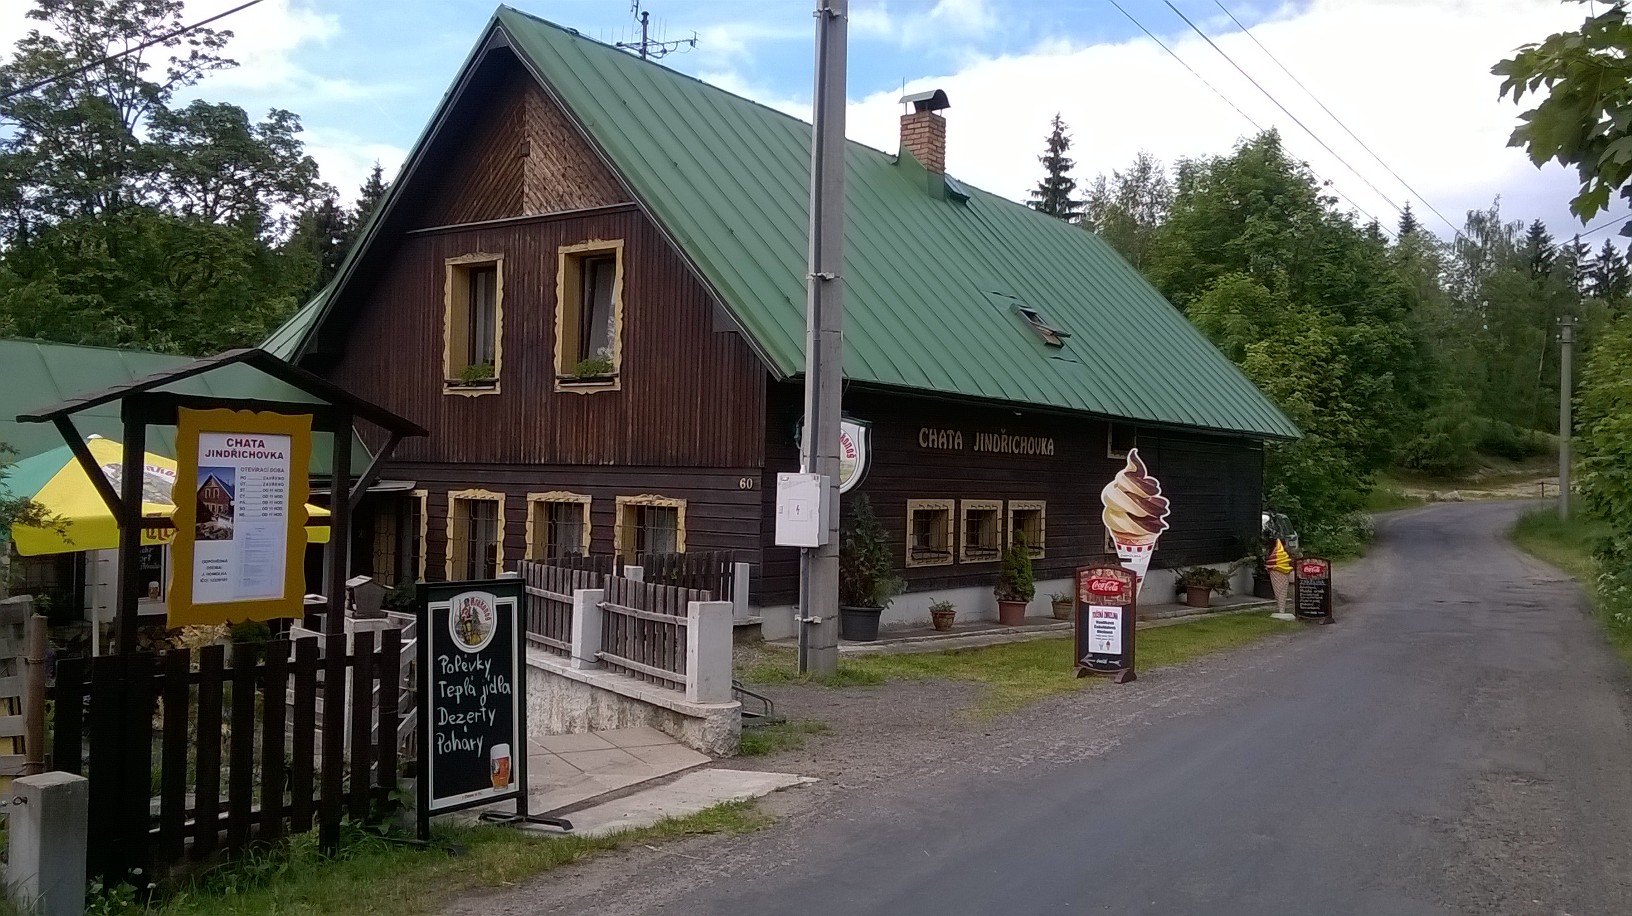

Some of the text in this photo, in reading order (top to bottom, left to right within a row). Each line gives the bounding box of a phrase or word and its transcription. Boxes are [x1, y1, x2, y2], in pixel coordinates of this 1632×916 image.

[226, 438, 265, 448] CHATA
[919, 427, 1054, 456] CHATA JINDŘICHOVKA
[205, 449, 284, 460] JINDŘICHOVKA
[739, 477, 753, 489] 60
[438, 674, 511, 706] Teplá jídla
[437, 706, 496, 726] Dezerty
[436, 725, 483, 758] Poháry
